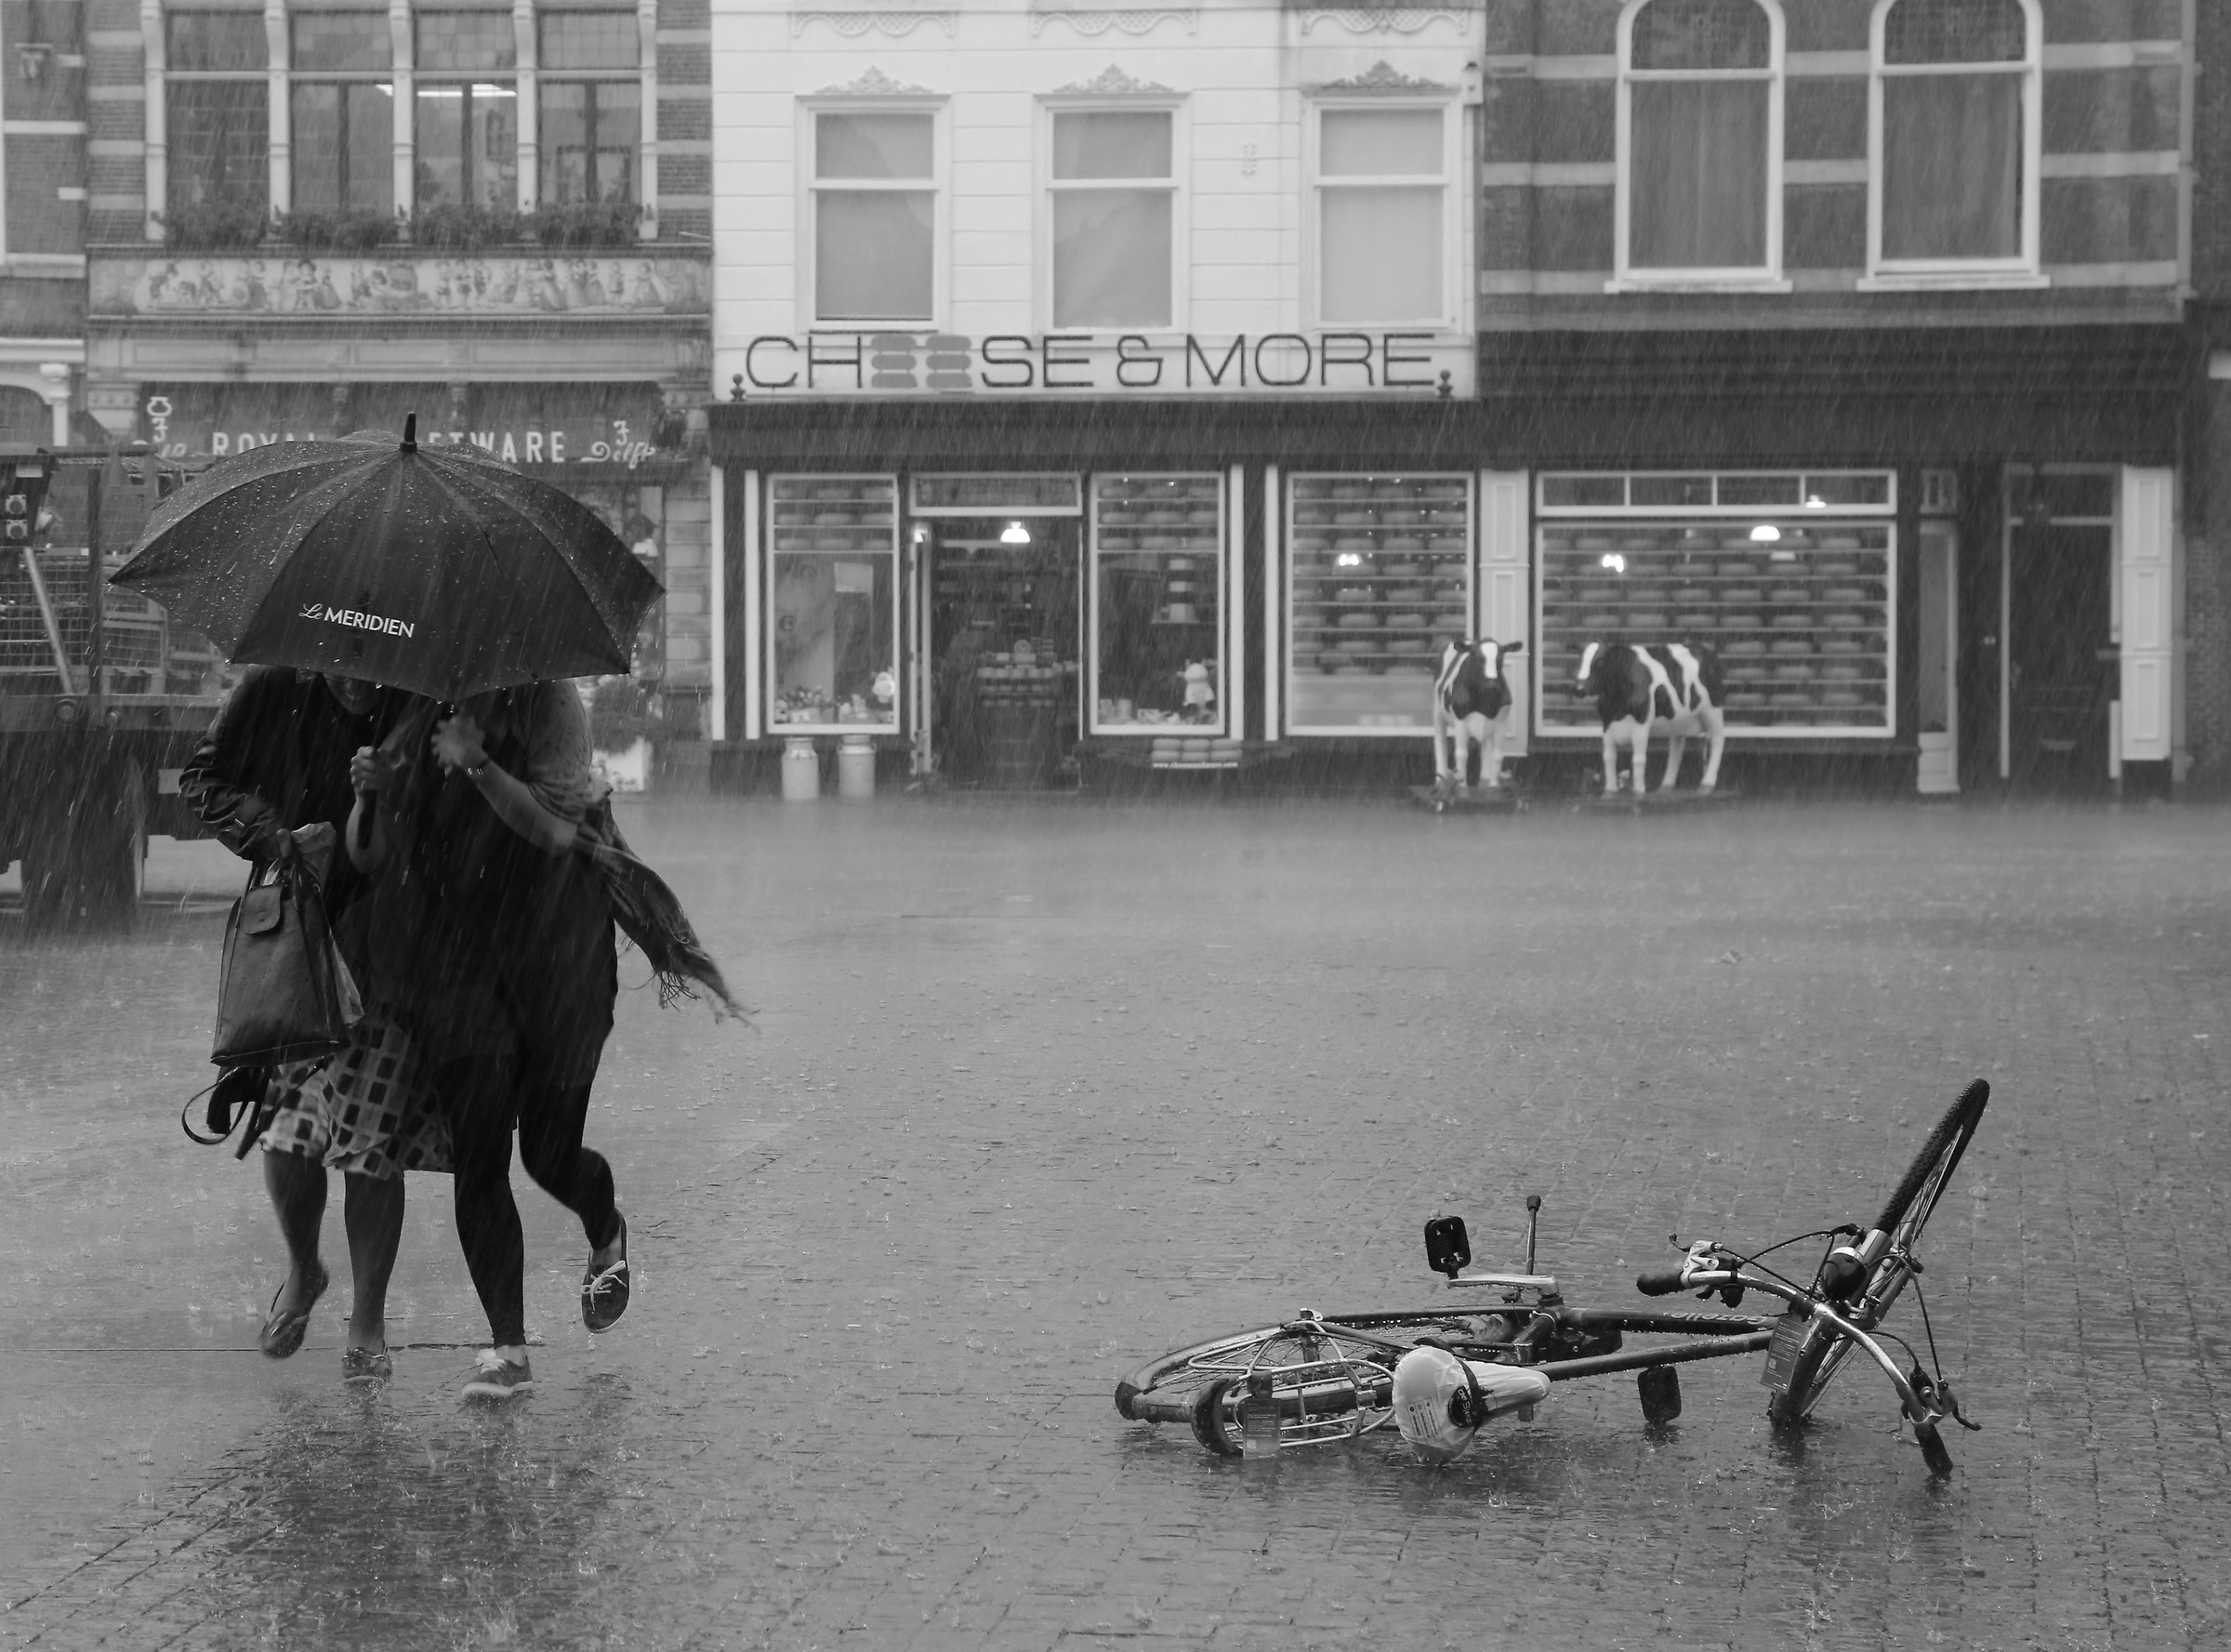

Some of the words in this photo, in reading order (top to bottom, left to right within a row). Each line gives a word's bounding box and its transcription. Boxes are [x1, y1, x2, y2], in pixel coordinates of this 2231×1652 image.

[1116, 336, 1164, 387] &
[1186, 334, 1435, 388] MORE
[298, 603, 323, 620] Le
[324, 606, 415, 639] MERIDIEN
[1670, 1312, 1767, 1326] Gazelle
